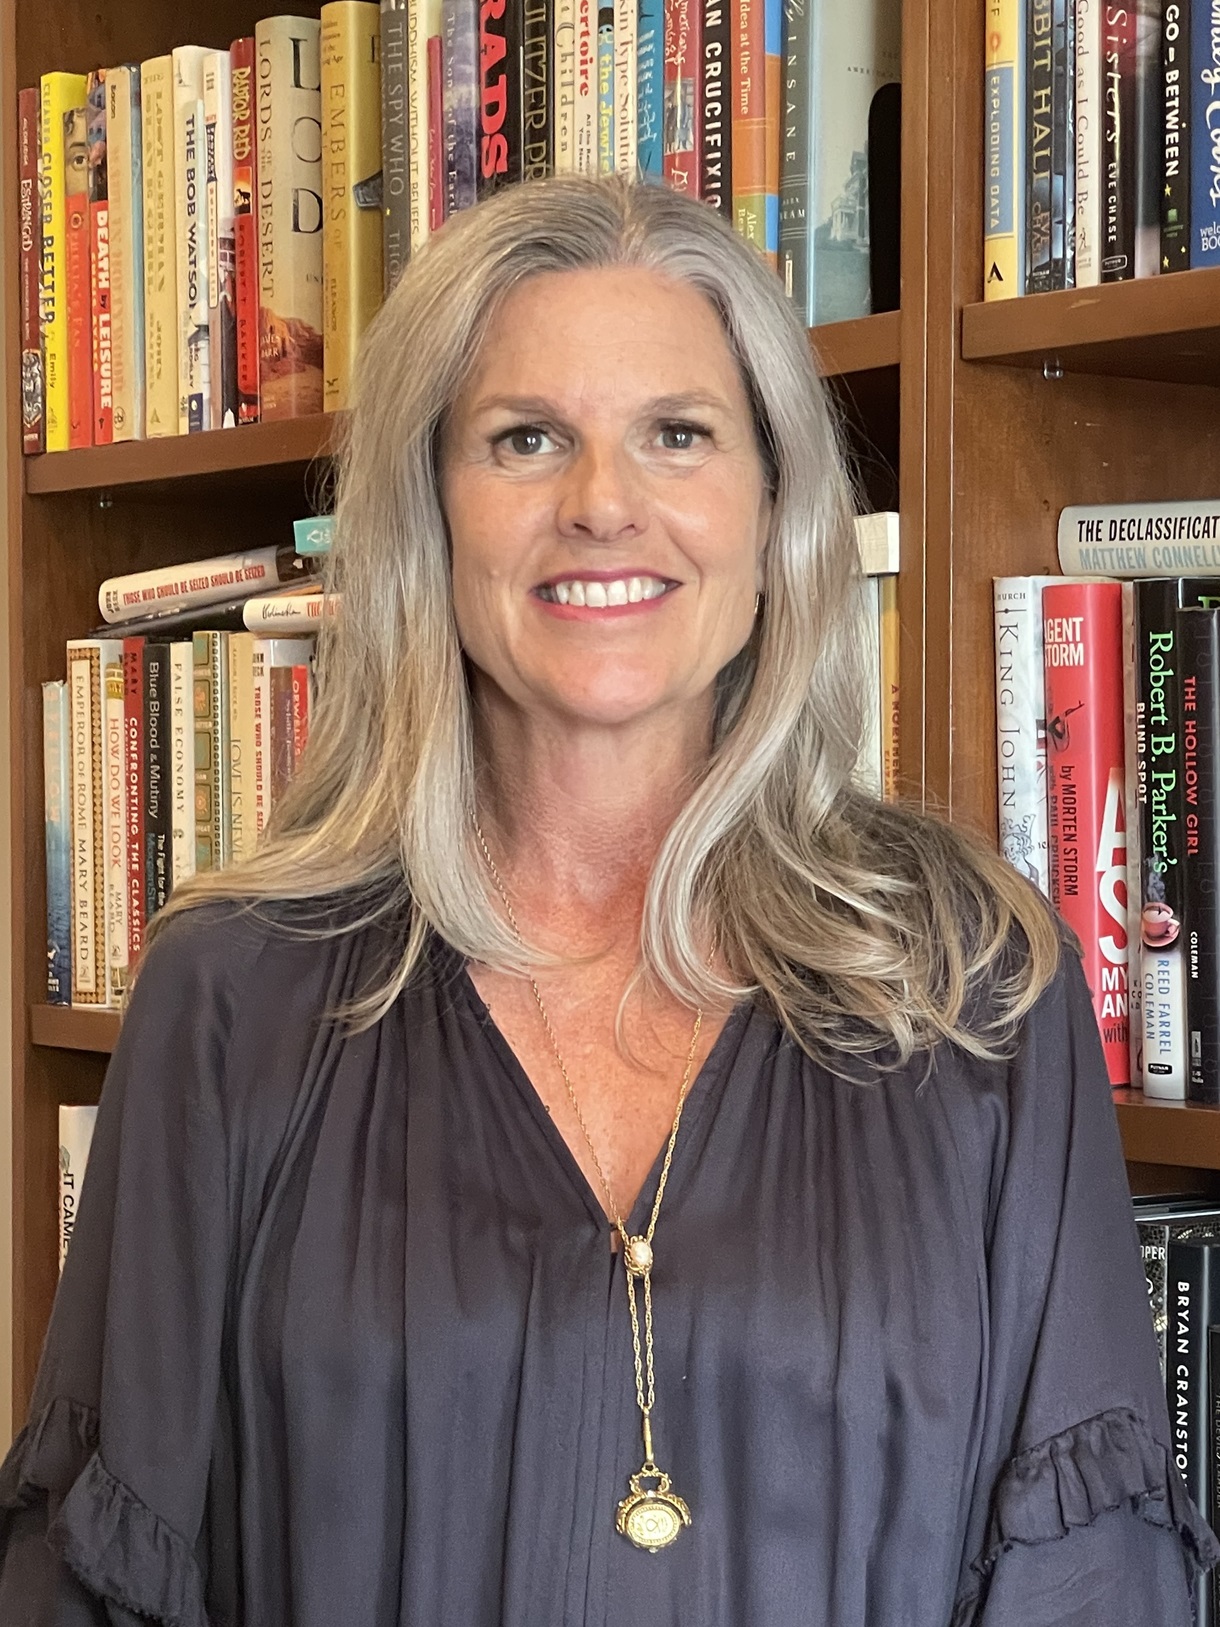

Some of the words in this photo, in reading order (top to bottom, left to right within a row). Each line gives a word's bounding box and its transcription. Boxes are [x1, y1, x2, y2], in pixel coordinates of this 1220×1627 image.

[387, 22, 403, 74] THE
[579, 0, 594, 98] ertoire
[739, 33, 751, 48] at
[1076, 0, 1091, 57] Good
[599, 54, 613, 96] the
[614, 33, 634, 87] Type
[740, 50, 752, 74] the
[1076, 67, 1086, 90] as
[1105, 5, 1128, 144] Sisters
[231, 66, 251, 123] RAPTOR
[259, 40, 272, 143] LORDS
[387, 83, 403, 126] SPY
[555, 22, 575, 154] Children
[740, 76, 753, 116] Time
[785, 35, 798, 162] INSANE
[185, 114, 196, 162] THE
[232, 124, 251, 161] RED
[447, 134, 457, 162] the
[989, 76, 1001, 178] EXPLODING
[1077, 115, 1091, 180] Could
[329, 84, 348, 222] EMBERS
[388, 134, 404, 197] WHO
[186, 167, 197, 217] BOB
[1107, 162, 1118, 190] EVE
[747, 211, 758, 240] Alex
[990, 184, 1001, 229] DATA
[1077, 190, 1090, 216] Be
[1107, 195, 1118, 244] CHASE
[97, 209, 110, 289] DEATH
[260, 179, 274, 298] DESERT
[1039, 211, 1051, 247] EVE
[48, 352, 57, 388] Emily
[99, 312, 113, 410] LEISURE
[1077, 519, 1104, 543] THE
[1079, 545, 1148, 571] MATTHEW
[122, 591, 142, 607] THOSE
[142, 587, 156, 601] WHO
[156, 582, 180, 599] SHOULD
[179, 580, 188, 594] BE
[188, 577, 210, 592] SEIZED
[210, 573, 234, 588] SHOULD
[235, 570, 244, 584] BE
[243, 564, 266, 580] SEIZED
[129, 656, 139, 695] MARY
[149, 661, 162, 698] Blue
[174, 663, 185, 717] FALSE
[1149, 629, 1176, 726] Robert
[1184, 675, 1197, 713] THE
[76, 675, 88, 756] EMPEROR
[253, 685, 263, 719] THOSE
[109, 717, 121, 759] HOW
[149, 700, 162, 750] Blood
[254, 722, 263, 747] WHO
[1136, 702, 1148, 754] BLIND
[1151, 732, 1176, 763] B.
[77, 760, 87, 778] OF
[110, 763, 121, 791] DO
[127, 716, 141, 835] CONFRONTING
[175, 726, 186, 814] ECONOMY
[254, 749, 264, 791] SHOULD
[1059, 765, 1076, 781] by
[1137, 760, 1149, 805] SPOT
[1184, 720, 1199, 807] HOLLOW
[77, 782, 89, 829] ROME
[110, 794, 121, 821] WE
[147, 764, 162, 819] Mutiny
[255, 794, 264, 808] BE
[1061, 783, 1078, 843] MORTEN
[156, 833, 166, 849] The
[1150, 769, 1179, 874] Parker's
[1186, 813, 1200, 859] GIRL
[77, 838, 90, 893] MARY
[110, 824, 122, 869] LOOK
[130, 841, 142, 871] THE
[155, 851, 167, 875] Fight
[157, 876, 167, 890] for
[1063, 846, 1079, 897] STORM
[113, 891, 123, 926] MARY
[130, 877, 143, 952] CLASSICS
[157, 891, 167, 907] the
[79, 898, 91, 961] BEARD
[1157, 959, 1171, 996] REED
[1190, 931, 1200, 980] COLEMAN
[1144, 972, 1156, 1041] COLEMAN
[1158, 1002, 1172, 1057] FARREL
[63, 1172, 75, 1190] IT
[1176, 1280, 1191, 1355] BRYAN
